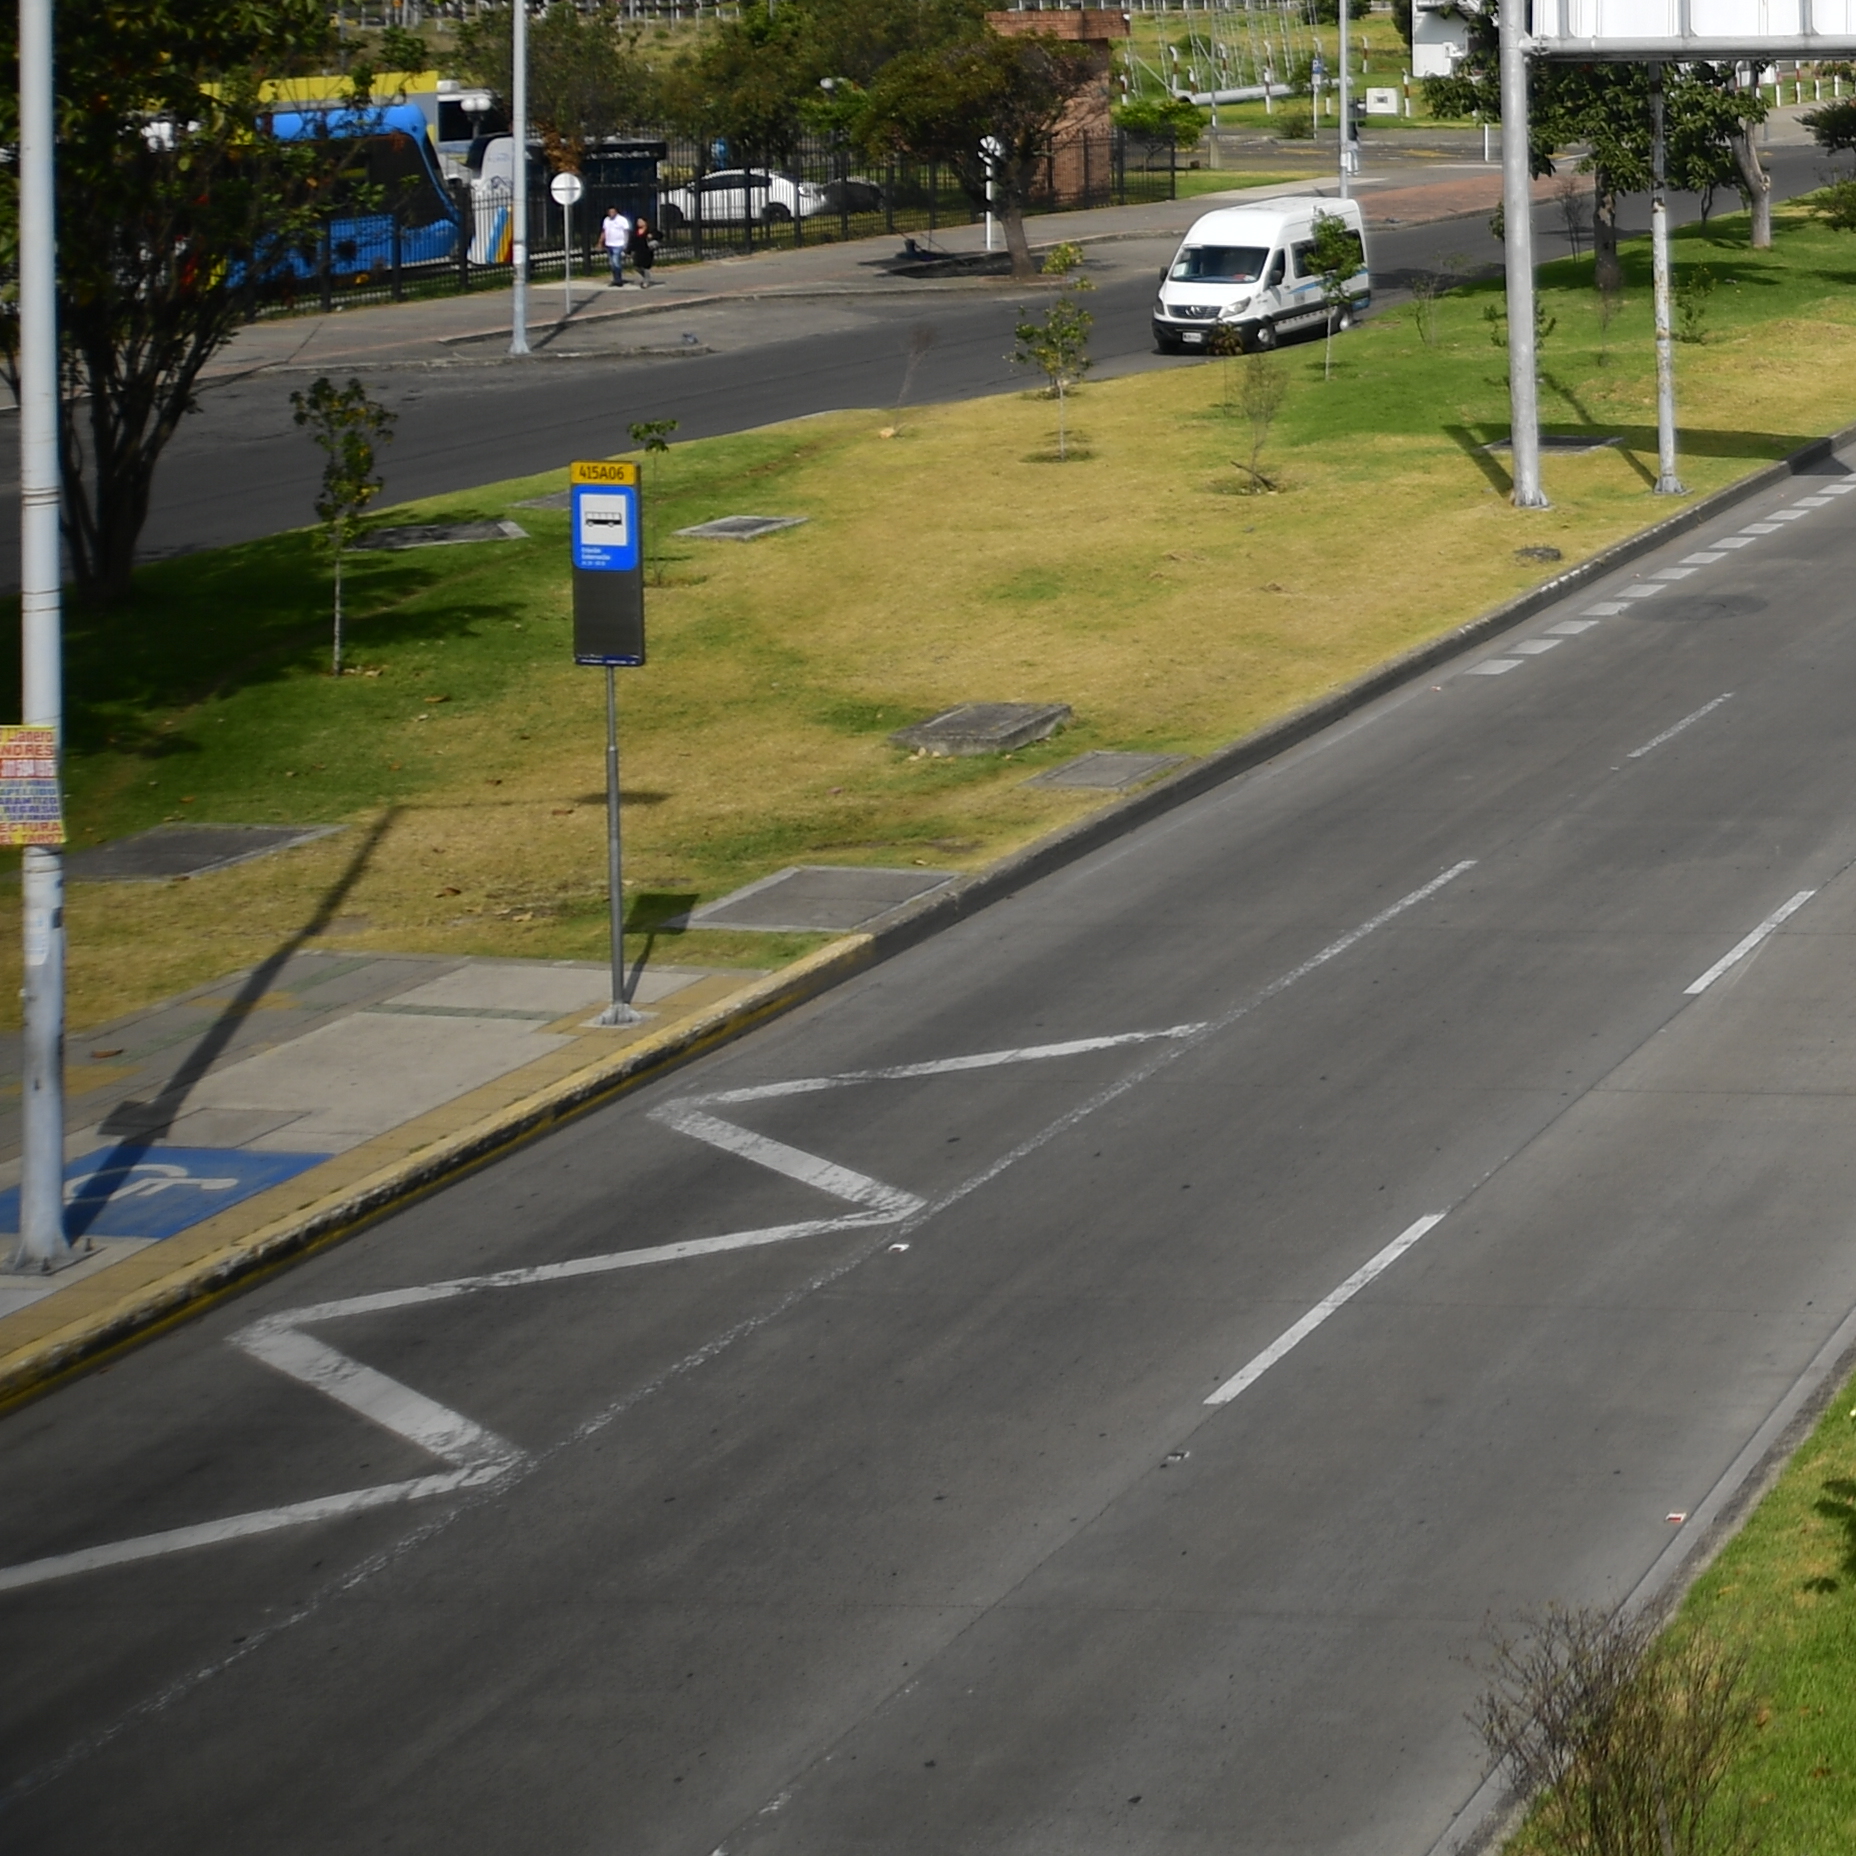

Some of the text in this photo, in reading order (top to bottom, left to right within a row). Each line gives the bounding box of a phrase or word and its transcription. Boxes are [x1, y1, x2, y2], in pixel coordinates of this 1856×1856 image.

[579, 465, 625, 480] 415A06
[0, 744, 54, 756] NDRES
[0, 822, 61, 832] ECTURA
